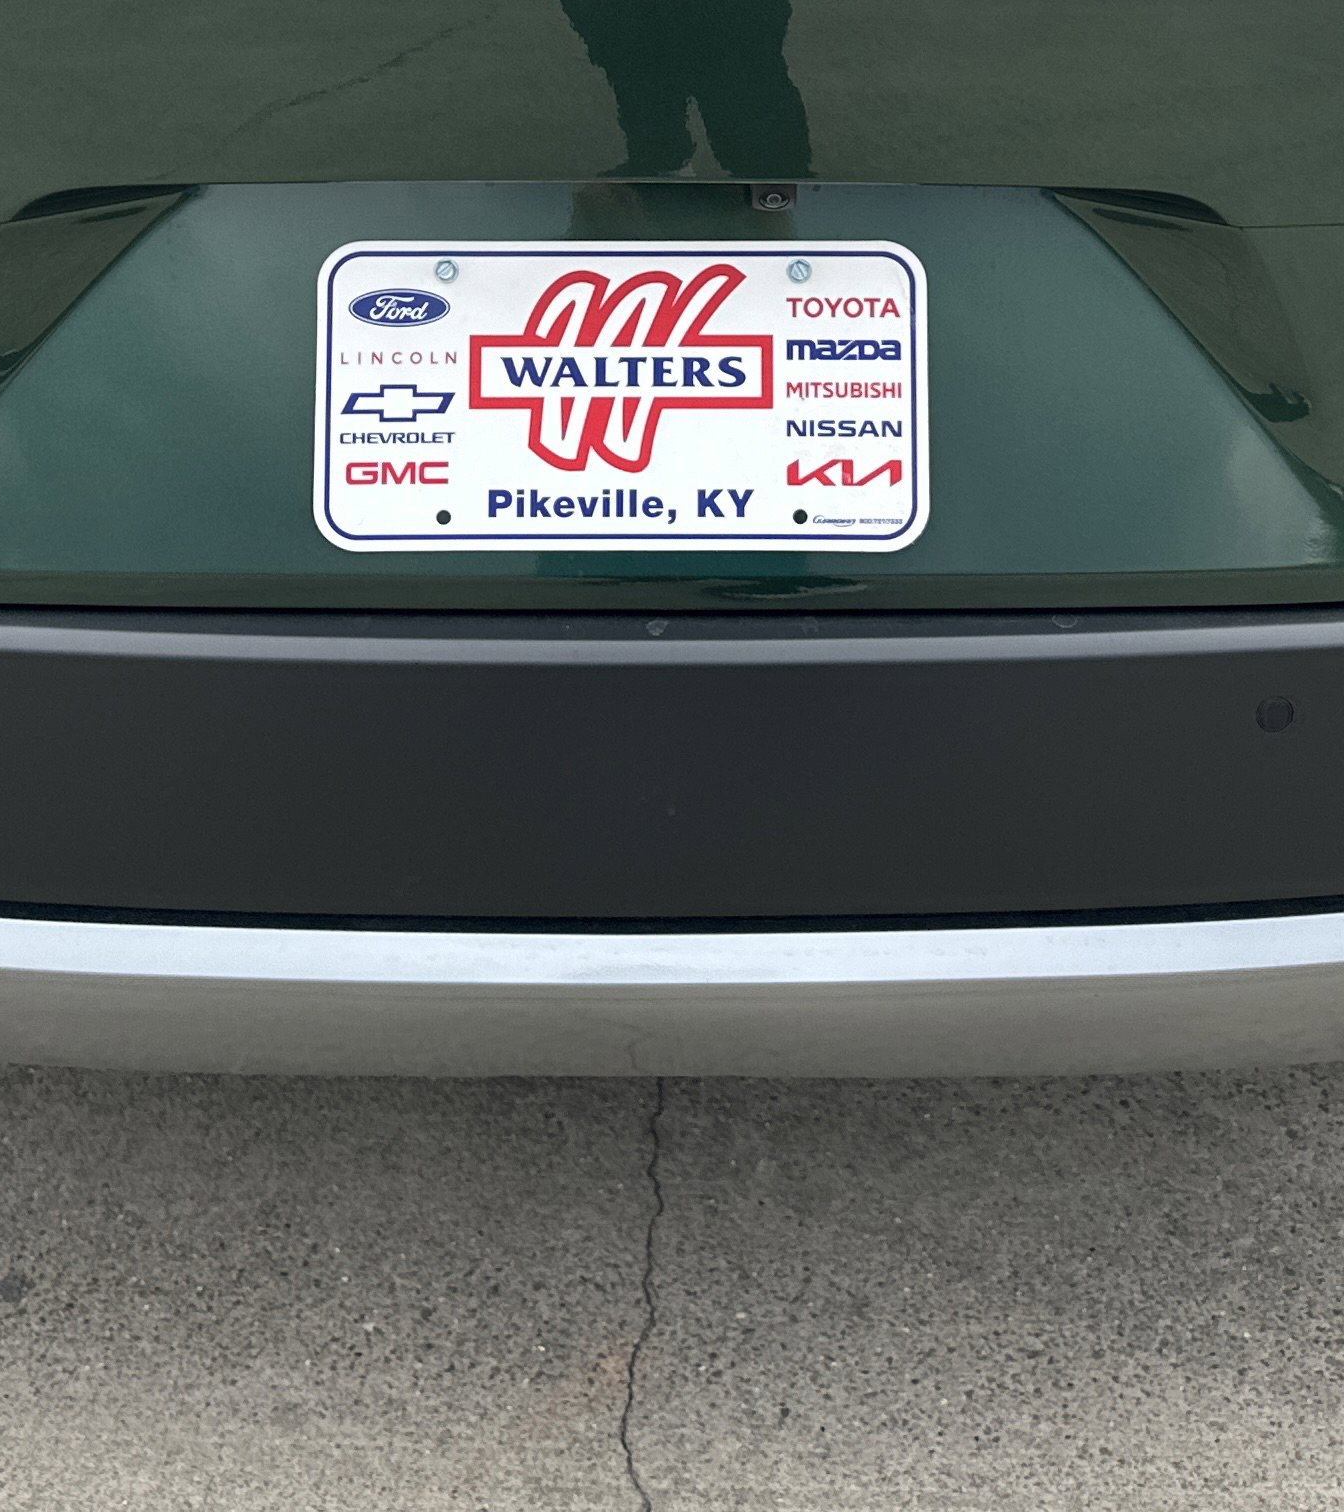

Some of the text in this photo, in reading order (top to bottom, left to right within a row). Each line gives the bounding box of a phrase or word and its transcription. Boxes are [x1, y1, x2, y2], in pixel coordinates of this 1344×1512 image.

[369, 294, 430, 321] Ford
[786, 296, 901, 319] TOYOTA
[340, 351, 458, 365] LINCOLN
[499, 355, 747, 388] WALTERS
[786, 381, 903, 399] MITSUBISHI
[339, 431, 456, 445] CHEVROLET
[786, 419, 903, 438] NISSAN
[345, 461, 449, 485] GMC
[786, 458, 903, 487] KIA
[487, 488, 755, 525] Pikeville, KY
